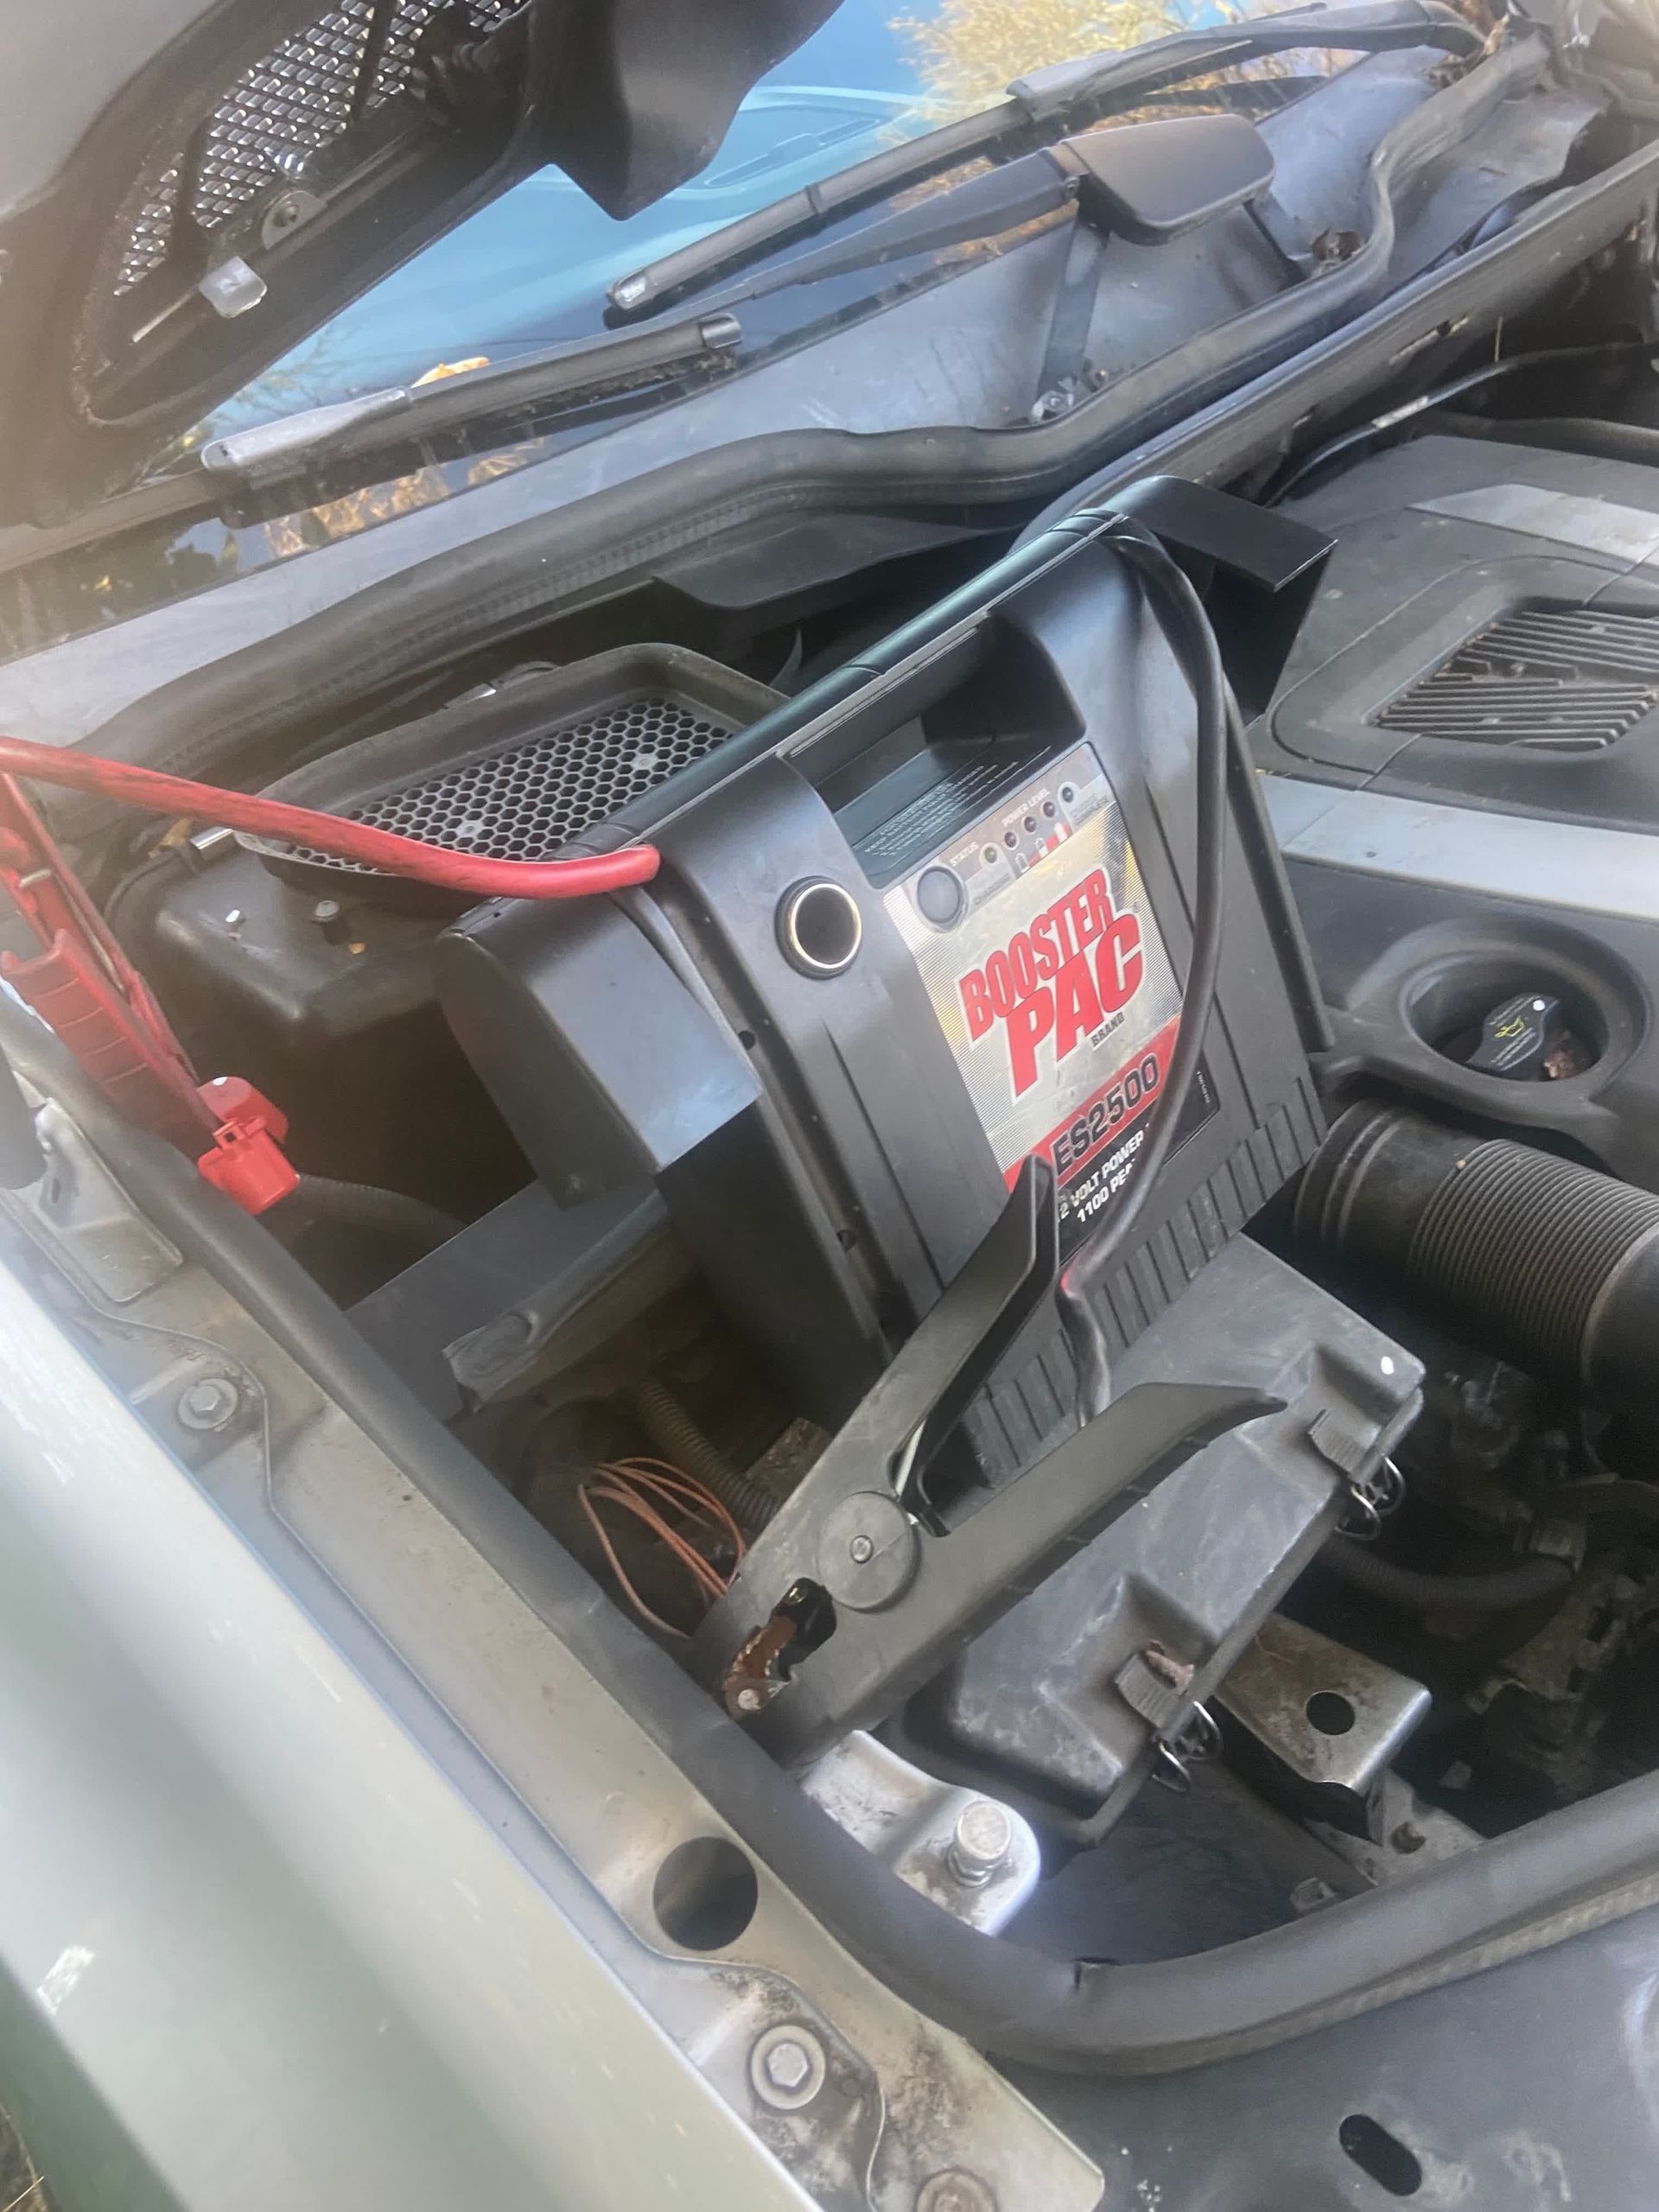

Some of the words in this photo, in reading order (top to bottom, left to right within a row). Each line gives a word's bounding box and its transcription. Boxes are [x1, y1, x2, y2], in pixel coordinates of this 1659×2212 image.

[1001, 802, 1029, 827] POWER
[1028, 788, 1051, 808] LEVEL
[950, 841, 979, 868] STATUS
[959, 869, 1111, 1040] BOOSTER
[1005, 913, 1142, 1096] PAC
[1091, 1013, 1125, 1047] BRAND
[1052, 1053, 1160, 1173] ES2500
[1071, 1171, 1100, 1208] VOLT
[1101, 1129, 1144, 1179] POWER
[1077, 1185, 1109, 1223] 1100
[1109, 1158, 1136, 1193] PEA
